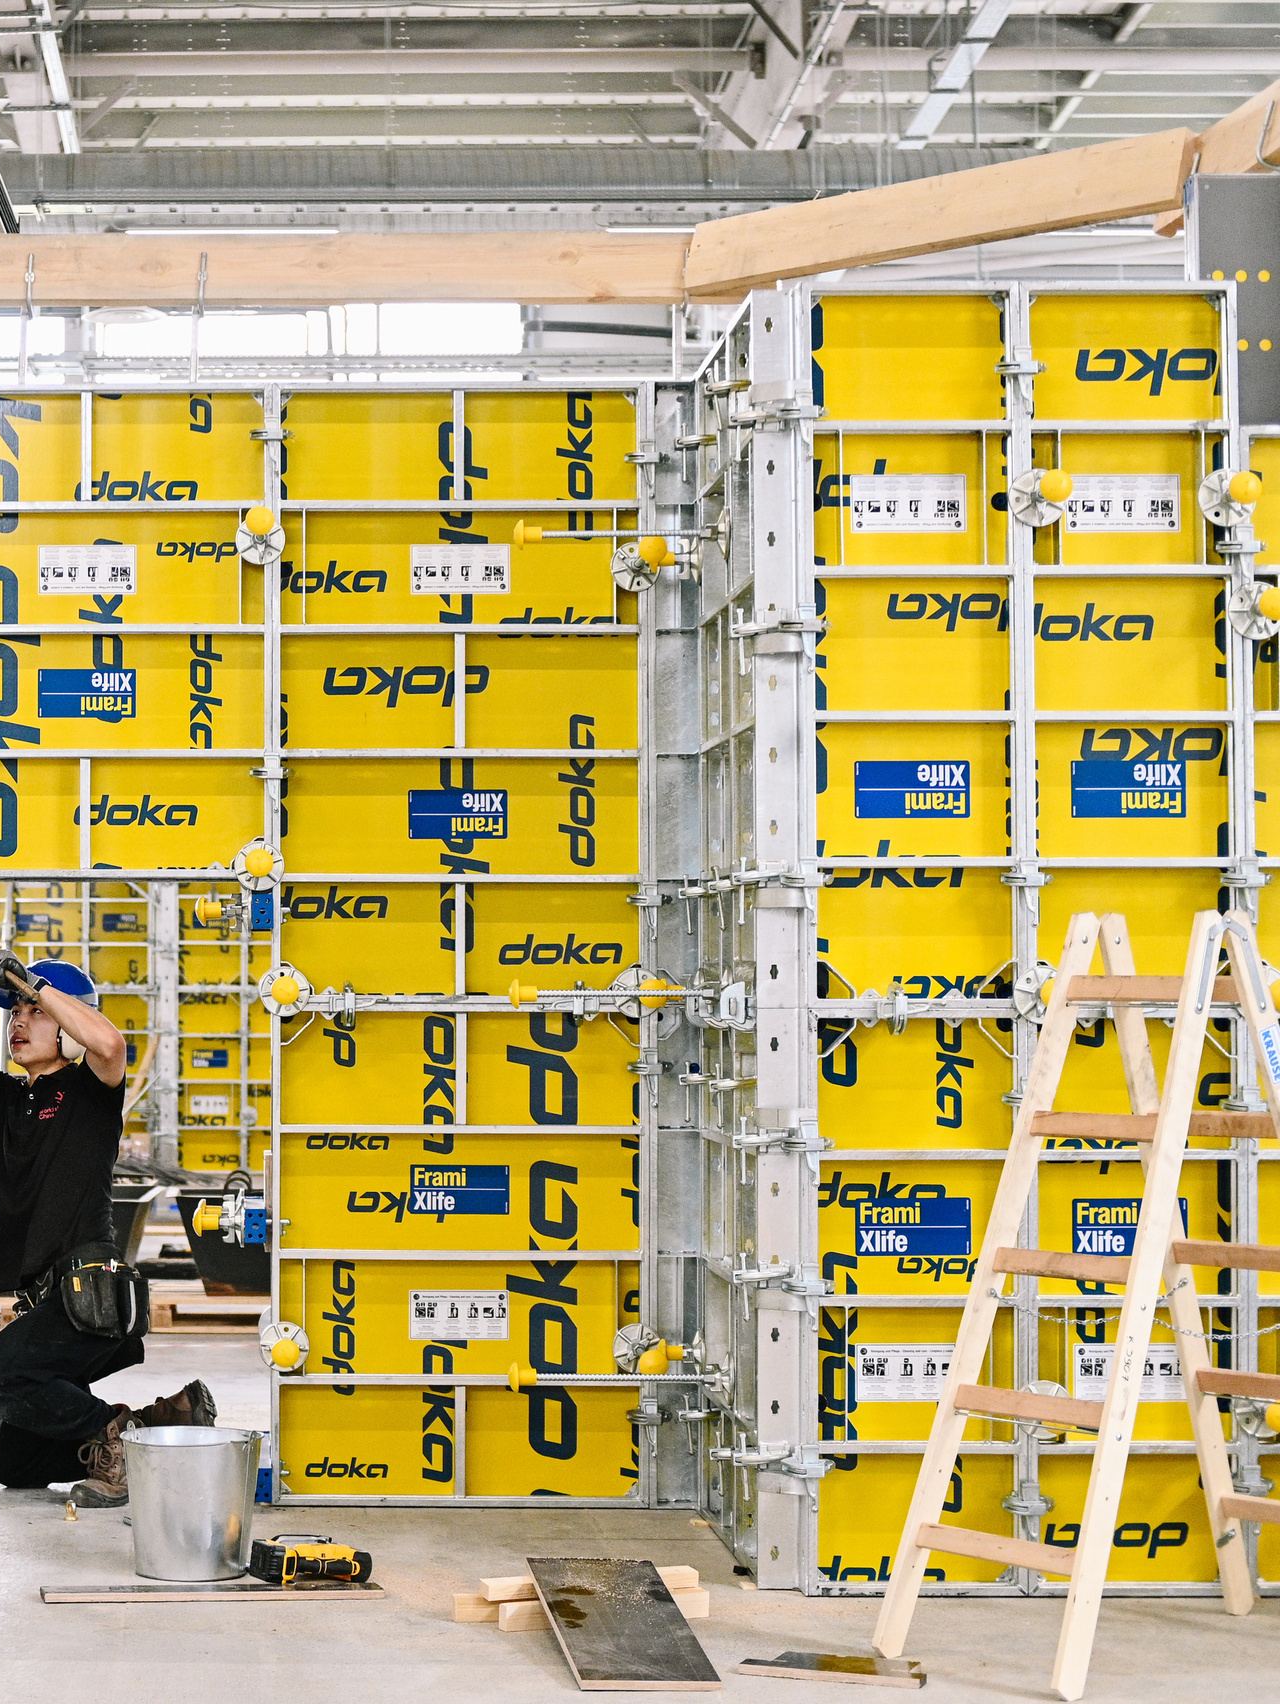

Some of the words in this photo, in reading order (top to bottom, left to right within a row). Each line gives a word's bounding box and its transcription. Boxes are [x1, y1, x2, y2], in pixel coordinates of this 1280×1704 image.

[557, 388, 593, 540] doka
[75, 472, 197, 501] doka
[156, 541, 241, 563] doka
[92, 673, 132, 691] Xlife
[324, 666, 489, 707] doka
[81, 697, 132, 715] Frami
[918, 765, 965, 786] Xlife
[1134, 764, 1181, 786] Xlife
[559, 715, 595, 866] doka
[74, 795, 197, 825] doka
[463, 793, 503, 812] Xlife
[905, 793, 965, 814] Frami
[1121, 792, 1181, 813] Frami
[452, 817, 503, 836] Frami
[500, 934, 622, 964] doka
[307, 1133, 389, 1149] doka
[415, 1168, 466, 1186] Frami
[414, 1192, 455, 1210] Xlife
[860, 1202, 920, 1224] Frami
[1077, 1202, 1137, 1224] Frami
[860, 1230, 907, 1252] Xlife
[1077, 1230, 1125, 1252] Xlife
[506, 1159, 579, 1462] doka
[323, 1260, 354, 1395] doka
[306, 1458, 387, 1477] doka
